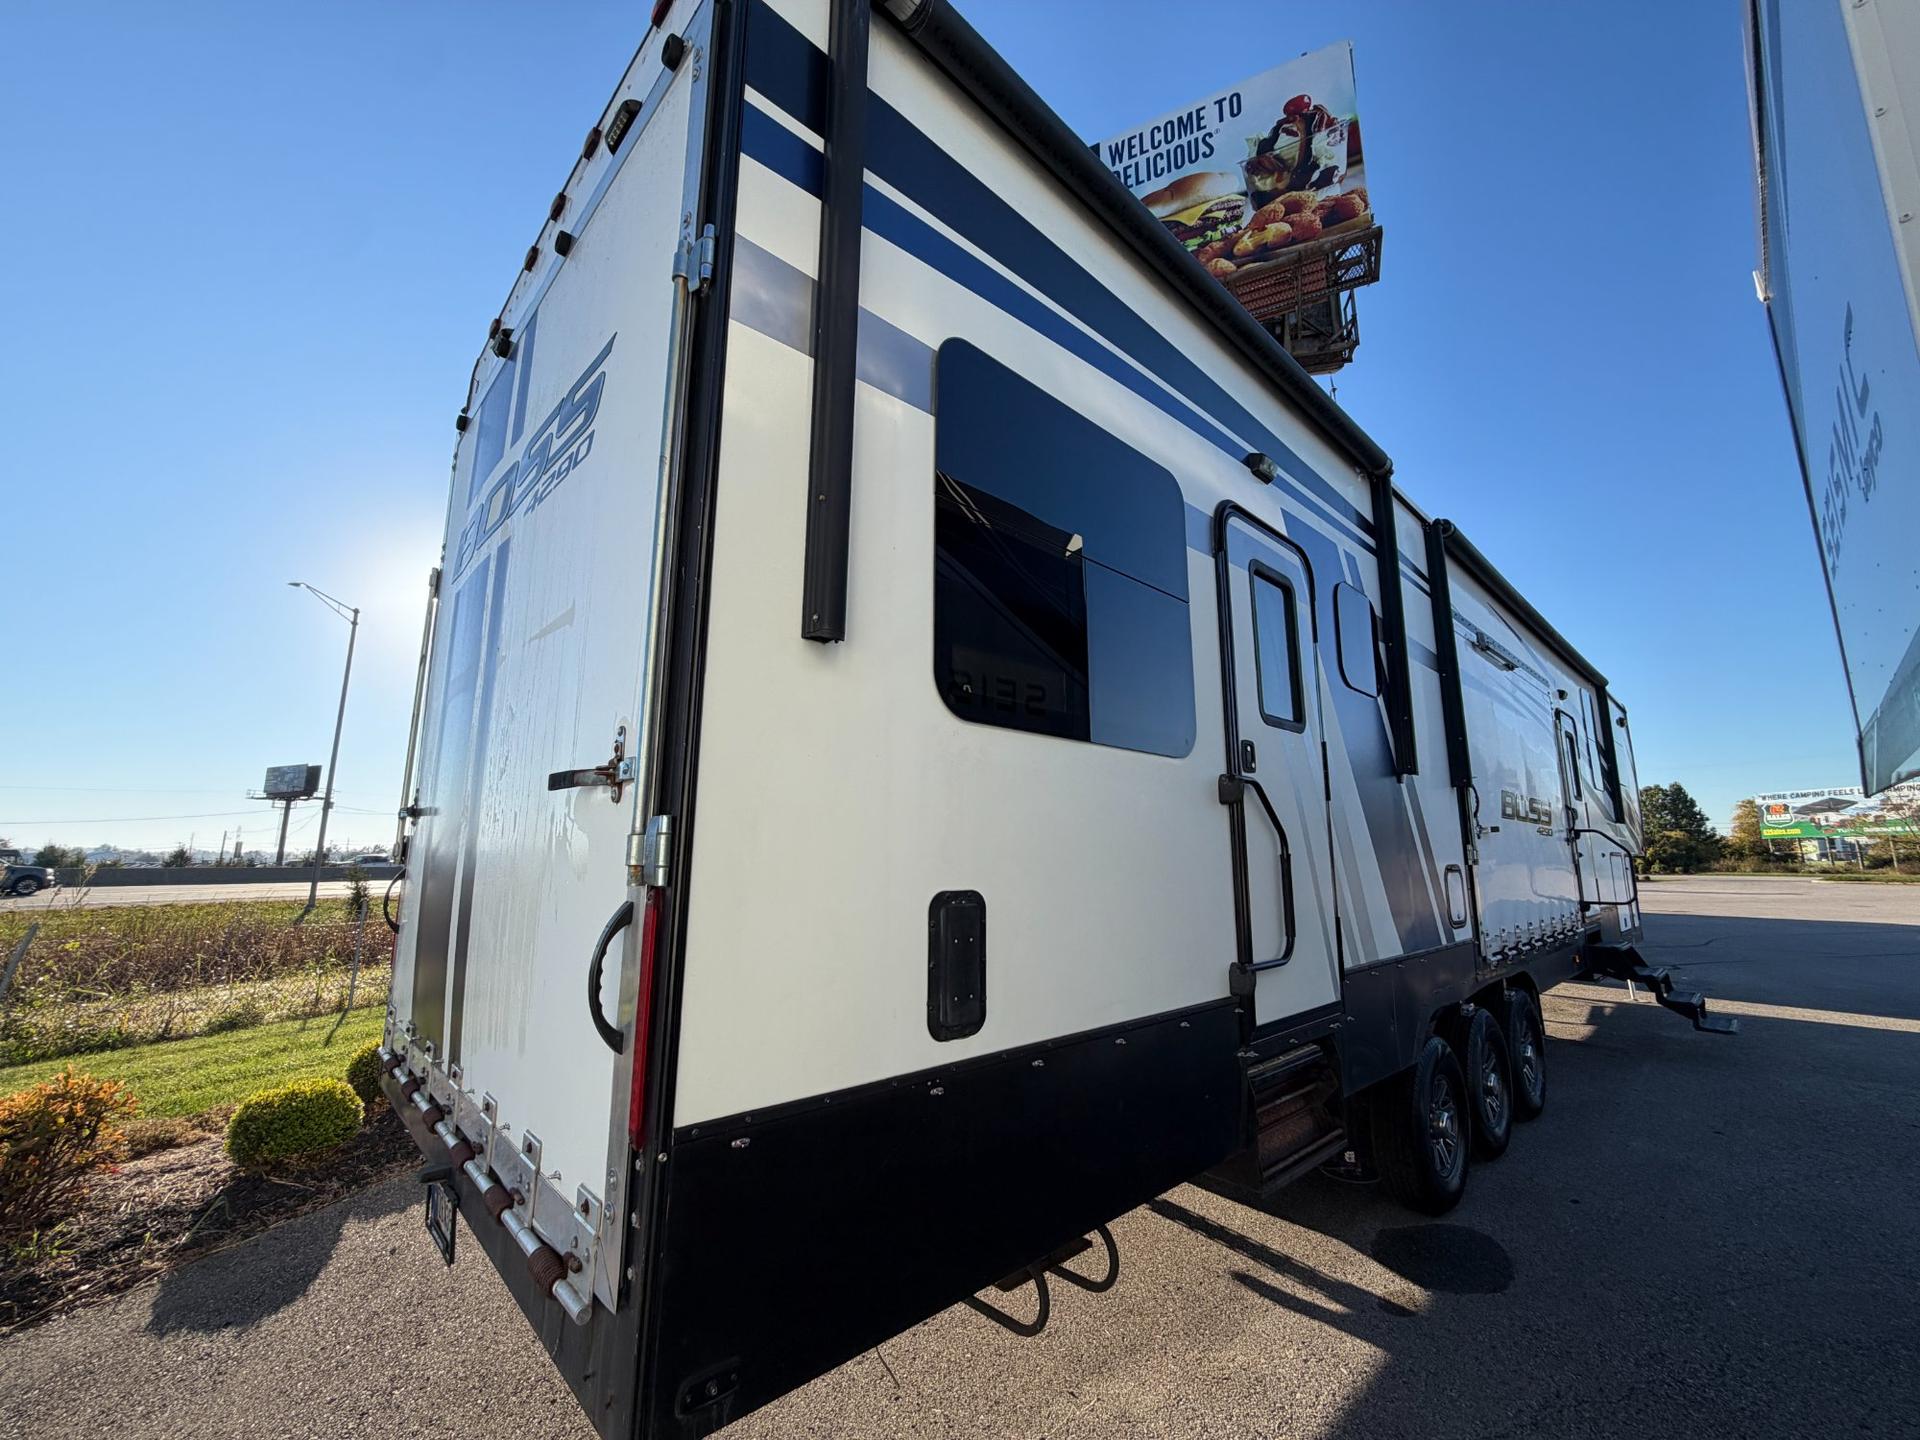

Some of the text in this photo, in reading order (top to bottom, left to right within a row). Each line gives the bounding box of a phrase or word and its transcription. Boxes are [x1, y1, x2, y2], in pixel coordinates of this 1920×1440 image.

[1108, 92, 1243, 167] WELCOME TO
[451, 331, 618, 585] BOSS
[524, 429, 595, 517] 4290
[1821, 301, 1870, 581] SEISMIC
[1759, 793, 1788, 801] WHERE
[1790, 791, 1825, 799] CAMPING
